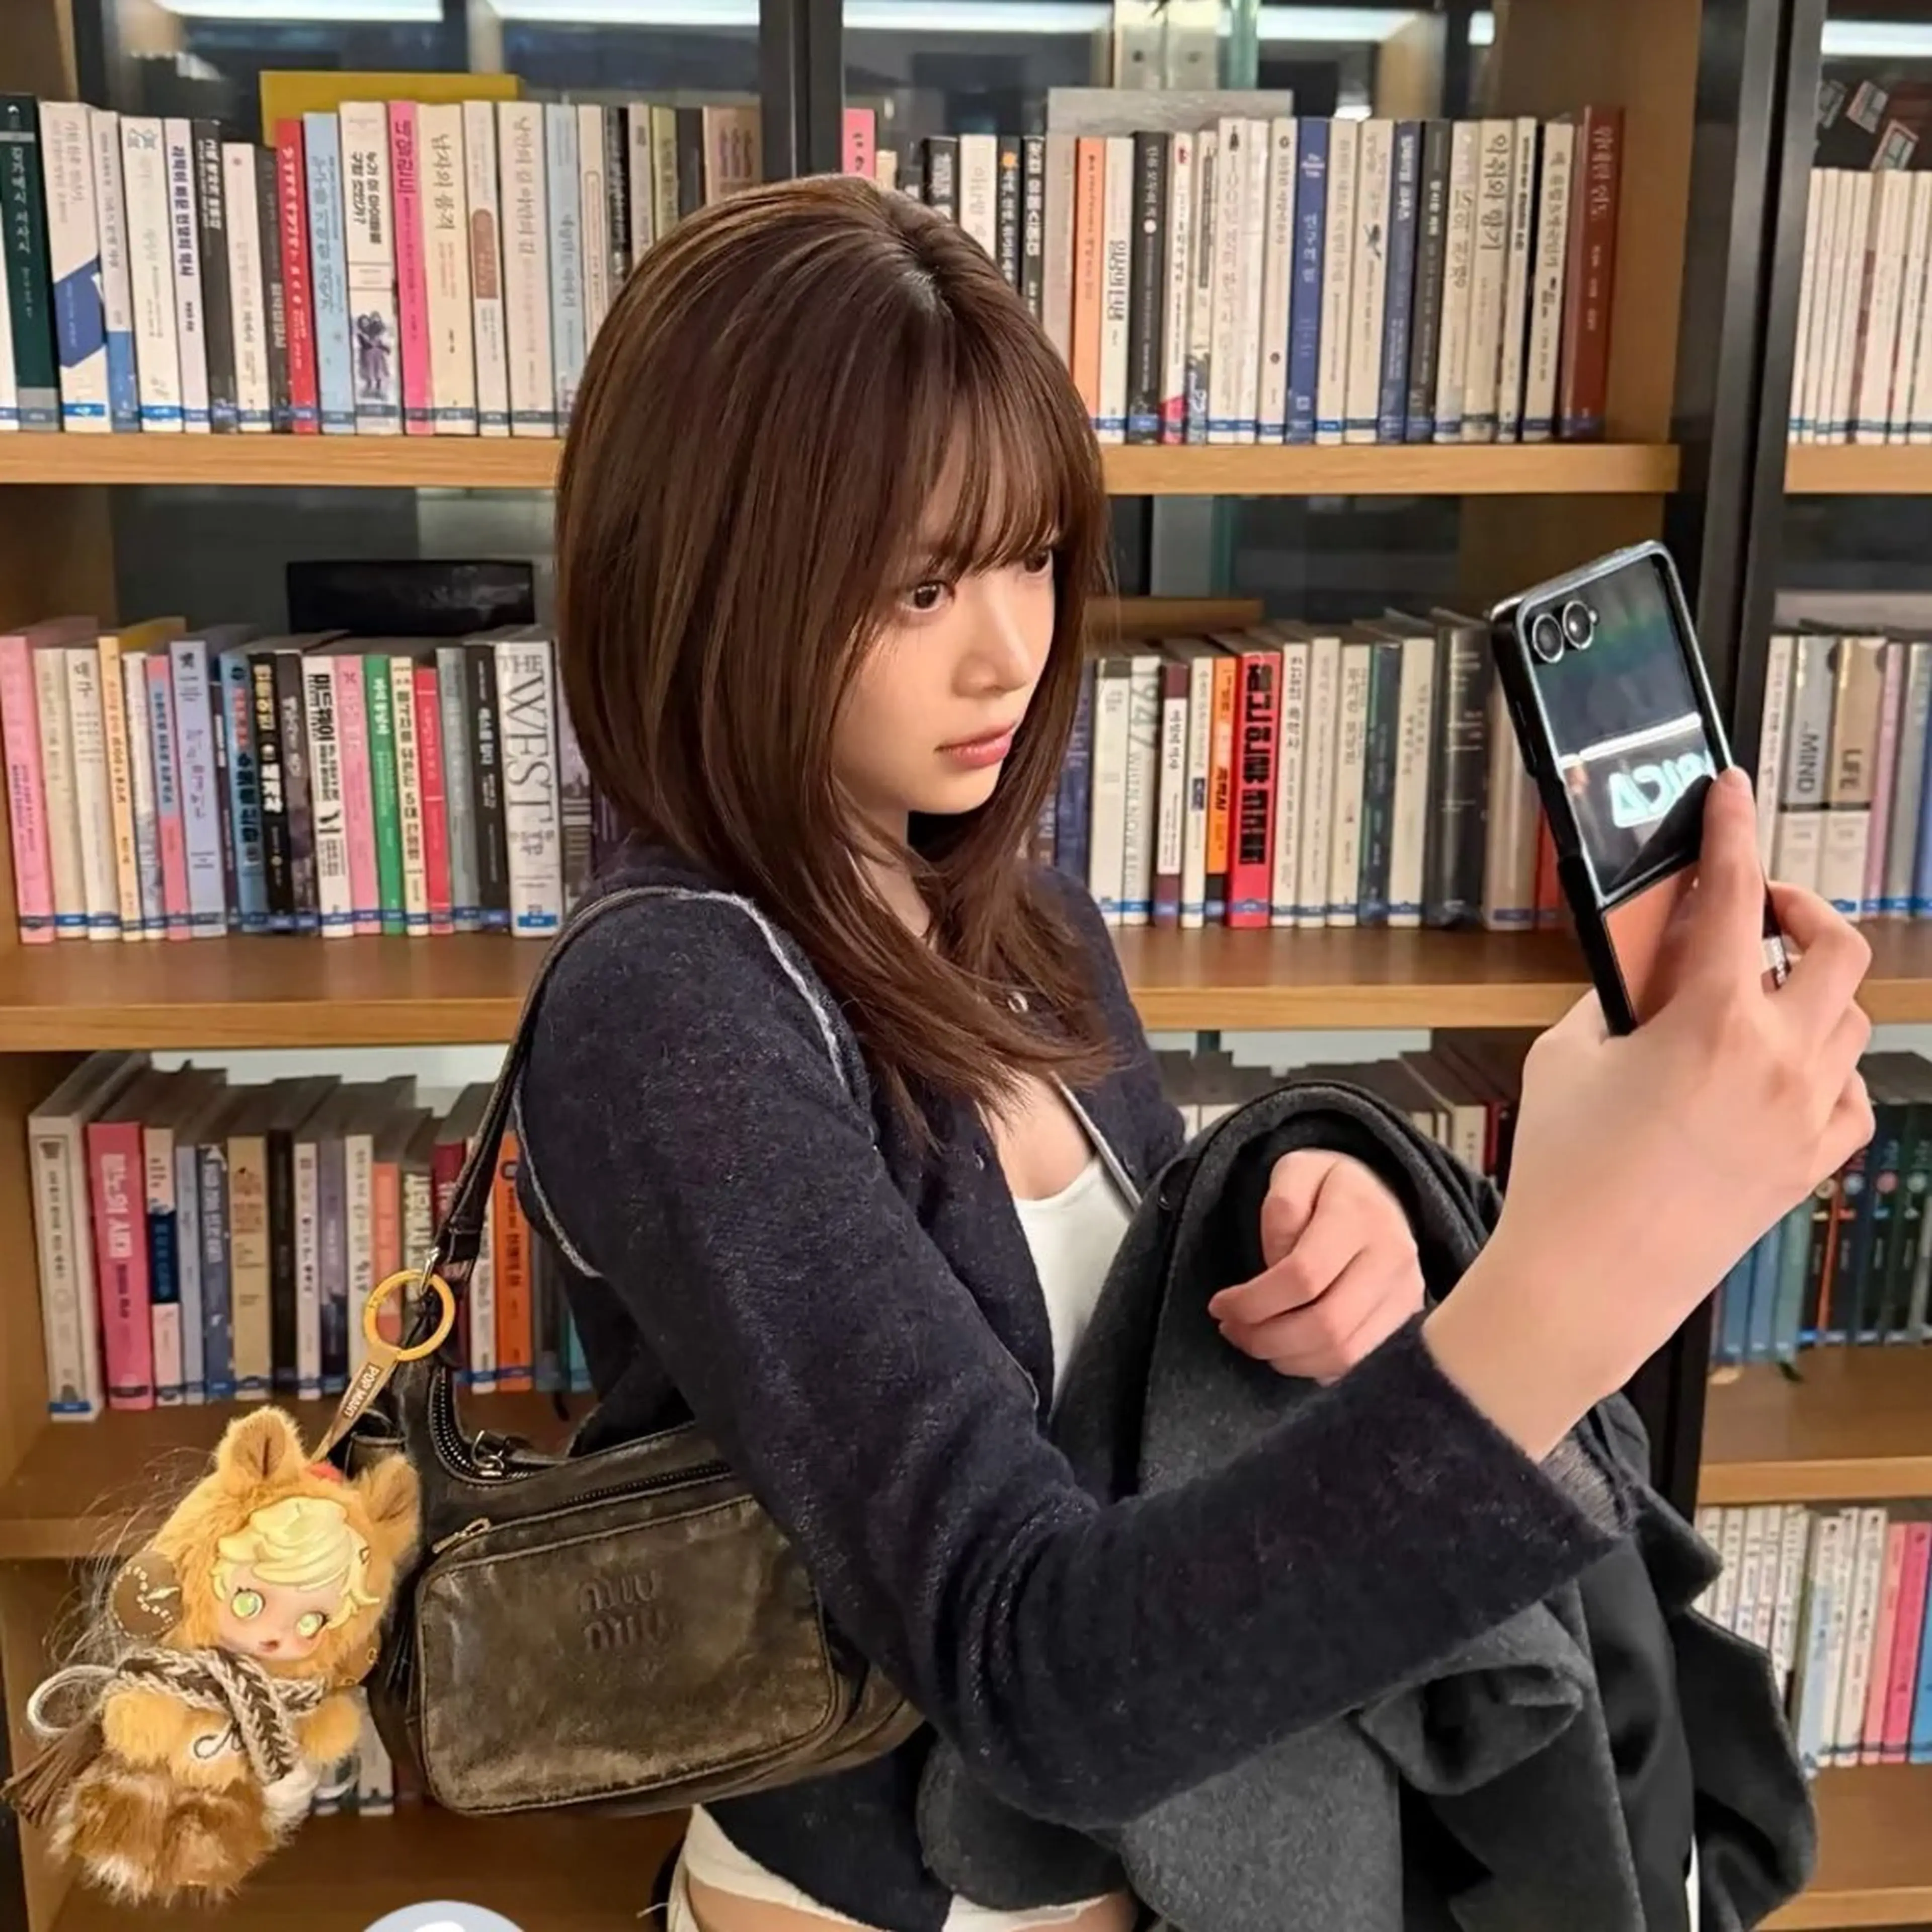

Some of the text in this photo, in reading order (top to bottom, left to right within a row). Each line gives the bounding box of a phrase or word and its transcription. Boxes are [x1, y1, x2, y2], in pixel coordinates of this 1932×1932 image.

[432, 133, 454, 187] 남자의
[1480, 134, 1509, 251] 악취와 향기
[1129, 665, 1159, 751] 1947
[505, 676, 553, 822] WEST
[1798, 734, 1820, 793] MIND
[361, 1364, 381, 1389] POP
